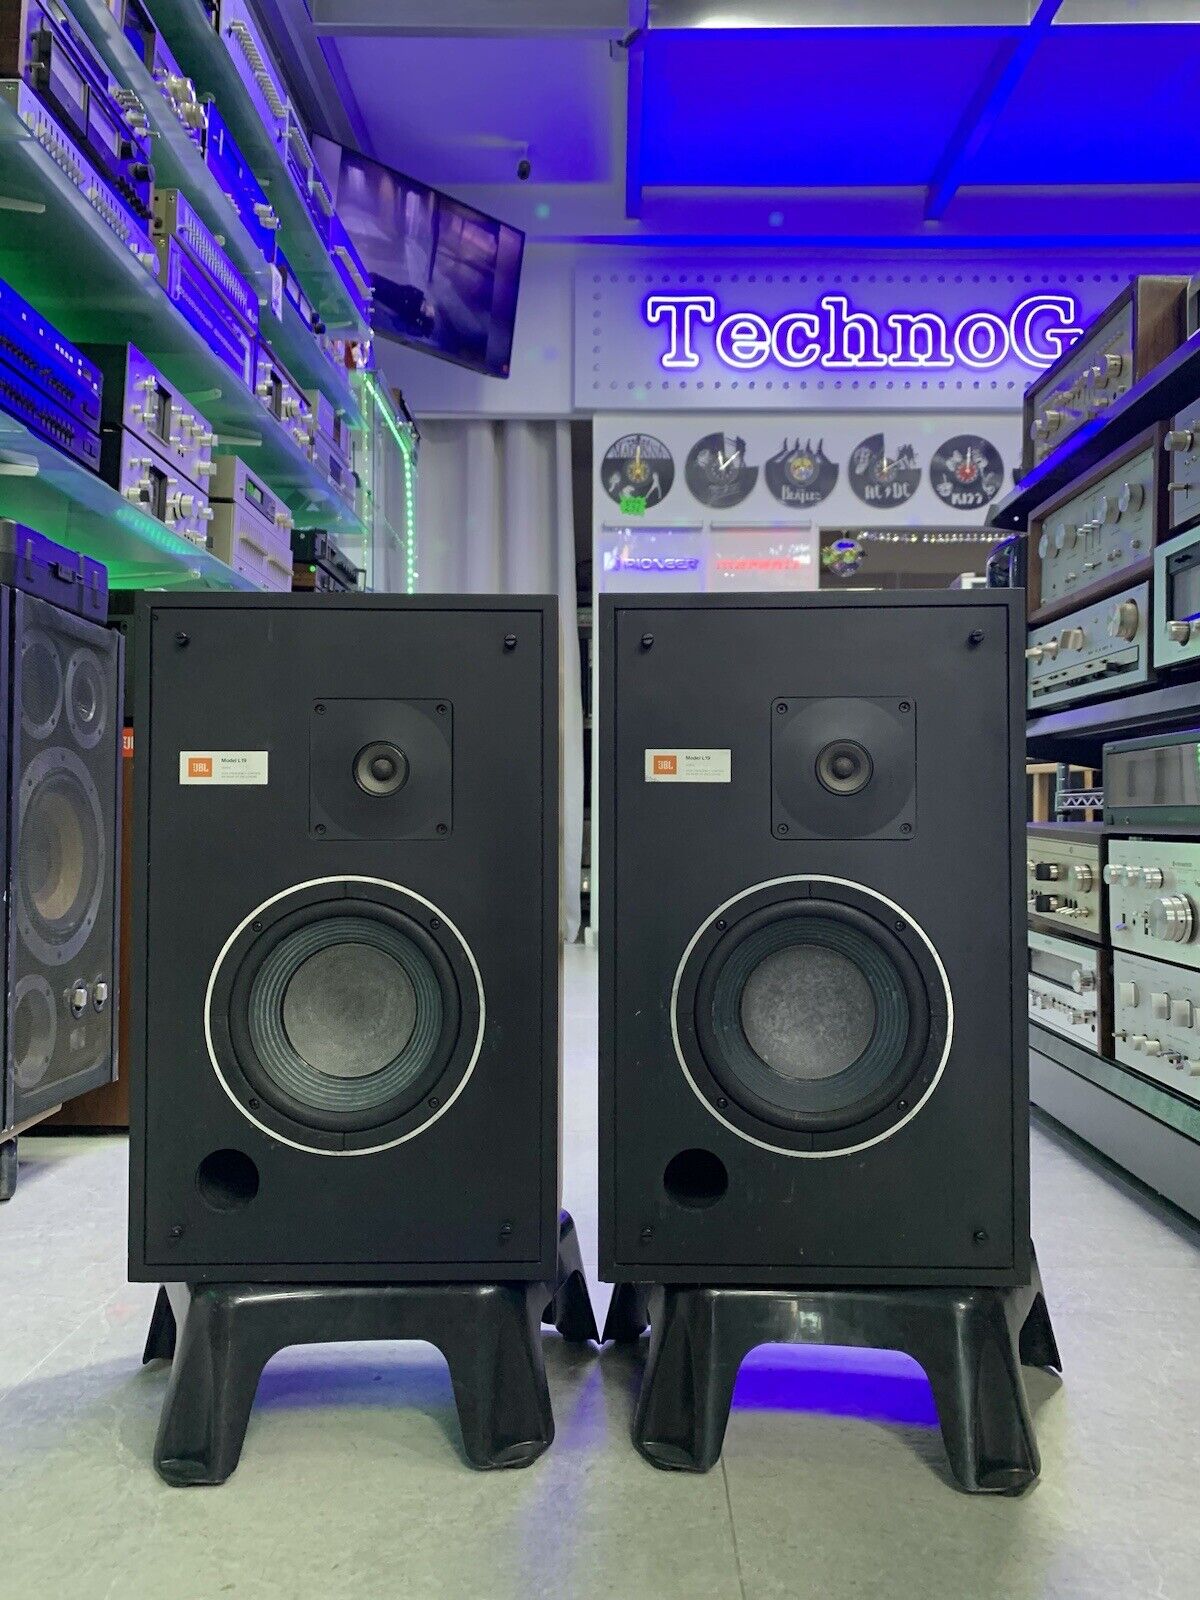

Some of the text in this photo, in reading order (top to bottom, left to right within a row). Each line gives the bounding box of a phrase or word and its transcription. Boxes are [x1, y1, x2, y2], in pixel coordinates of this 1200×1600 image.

[646, 295, 1084, 369] TechnoG
[193, 763, 209, 772] JBL
[658, 760, 673, 770] JBL
